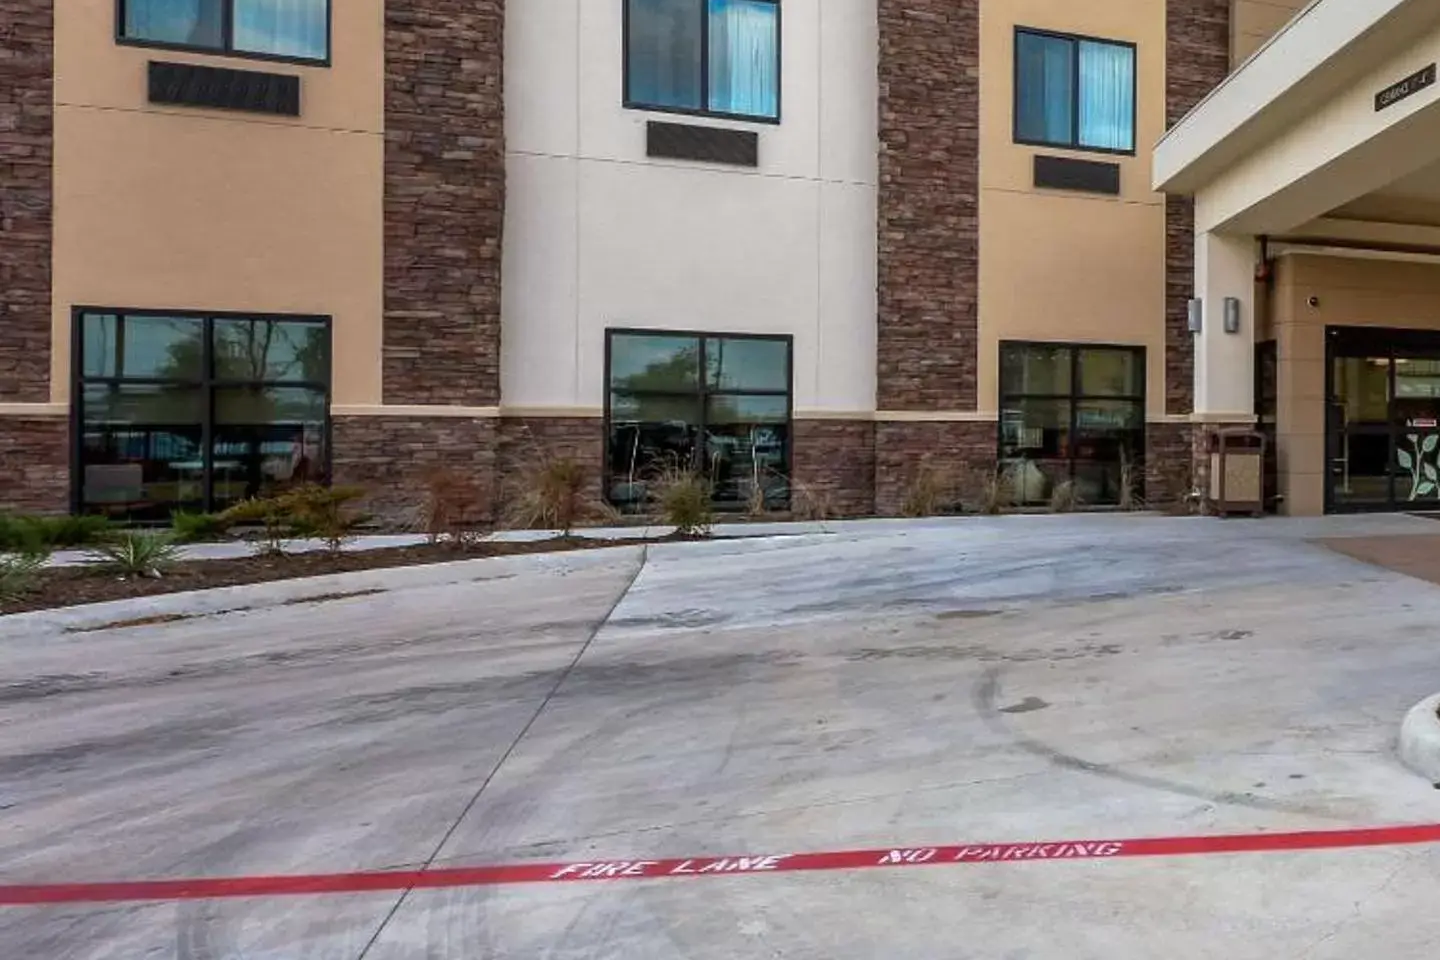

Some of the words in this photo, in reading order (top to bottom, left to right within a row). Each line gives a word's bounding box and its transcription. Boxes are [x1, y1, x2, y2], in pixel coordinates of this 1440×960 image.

[550, 861, 658, 879] FIRE
[670, 854, 794, 873] LANE
[878, 847, 938, 864] NO
[954, 842, 1122, 860] PARKING
